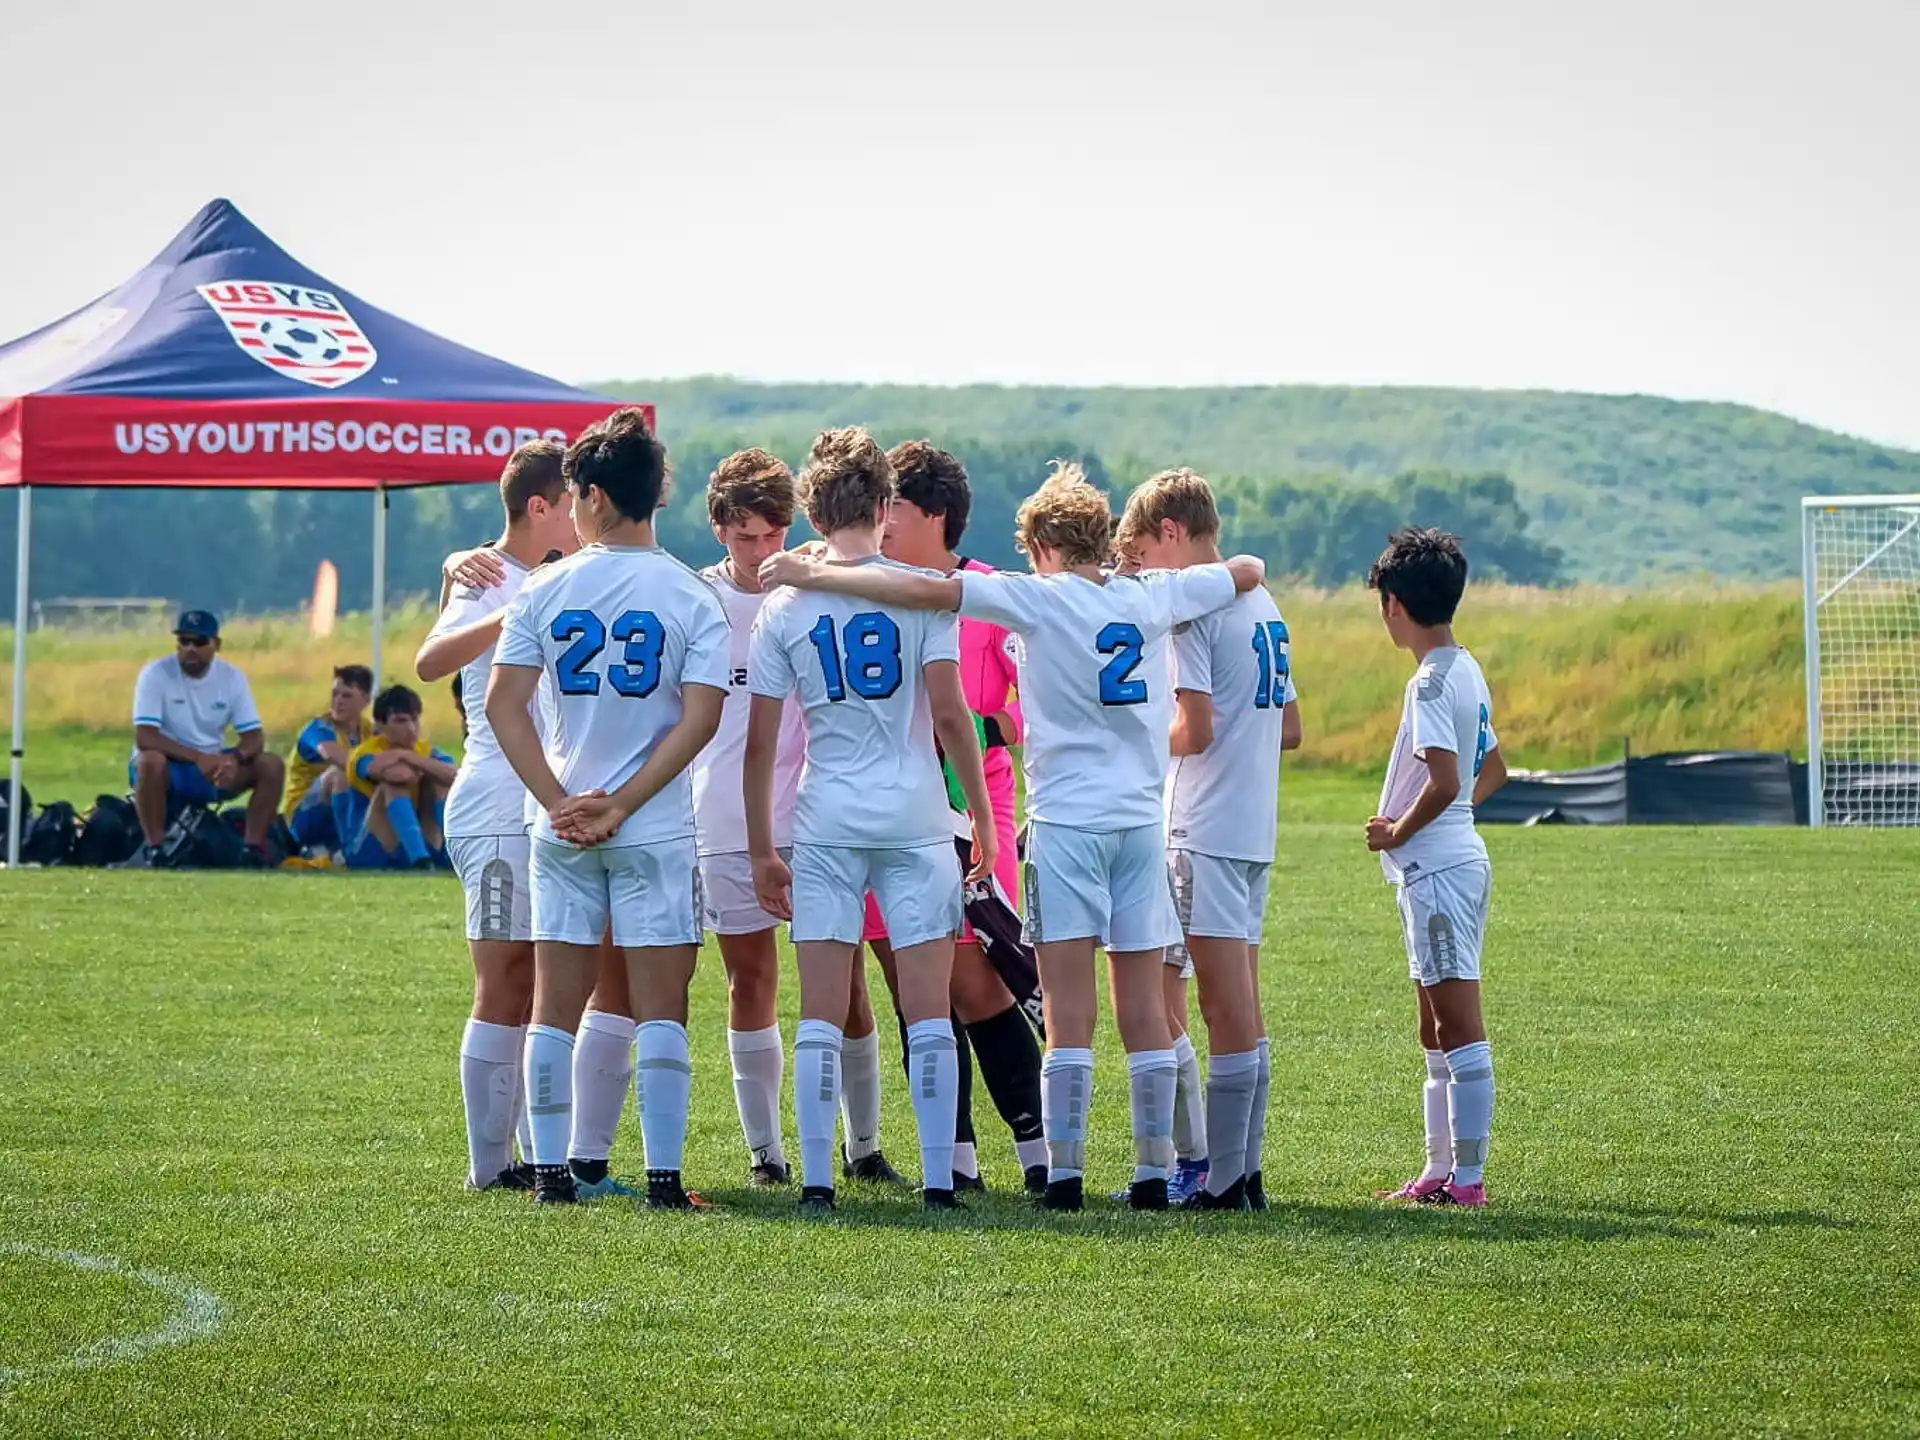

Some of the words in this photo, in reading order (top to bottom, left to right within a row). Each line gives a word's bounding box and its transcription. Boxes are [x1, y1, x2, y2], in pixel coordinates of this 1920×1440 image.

[206, 283, 340, 312] USYS
[550, 609, 666, 698] 23
[808, 611, 903, 702] 18
[1095, 622, 1148, 706] 2
[1252, 620, 1290, 709] 15
